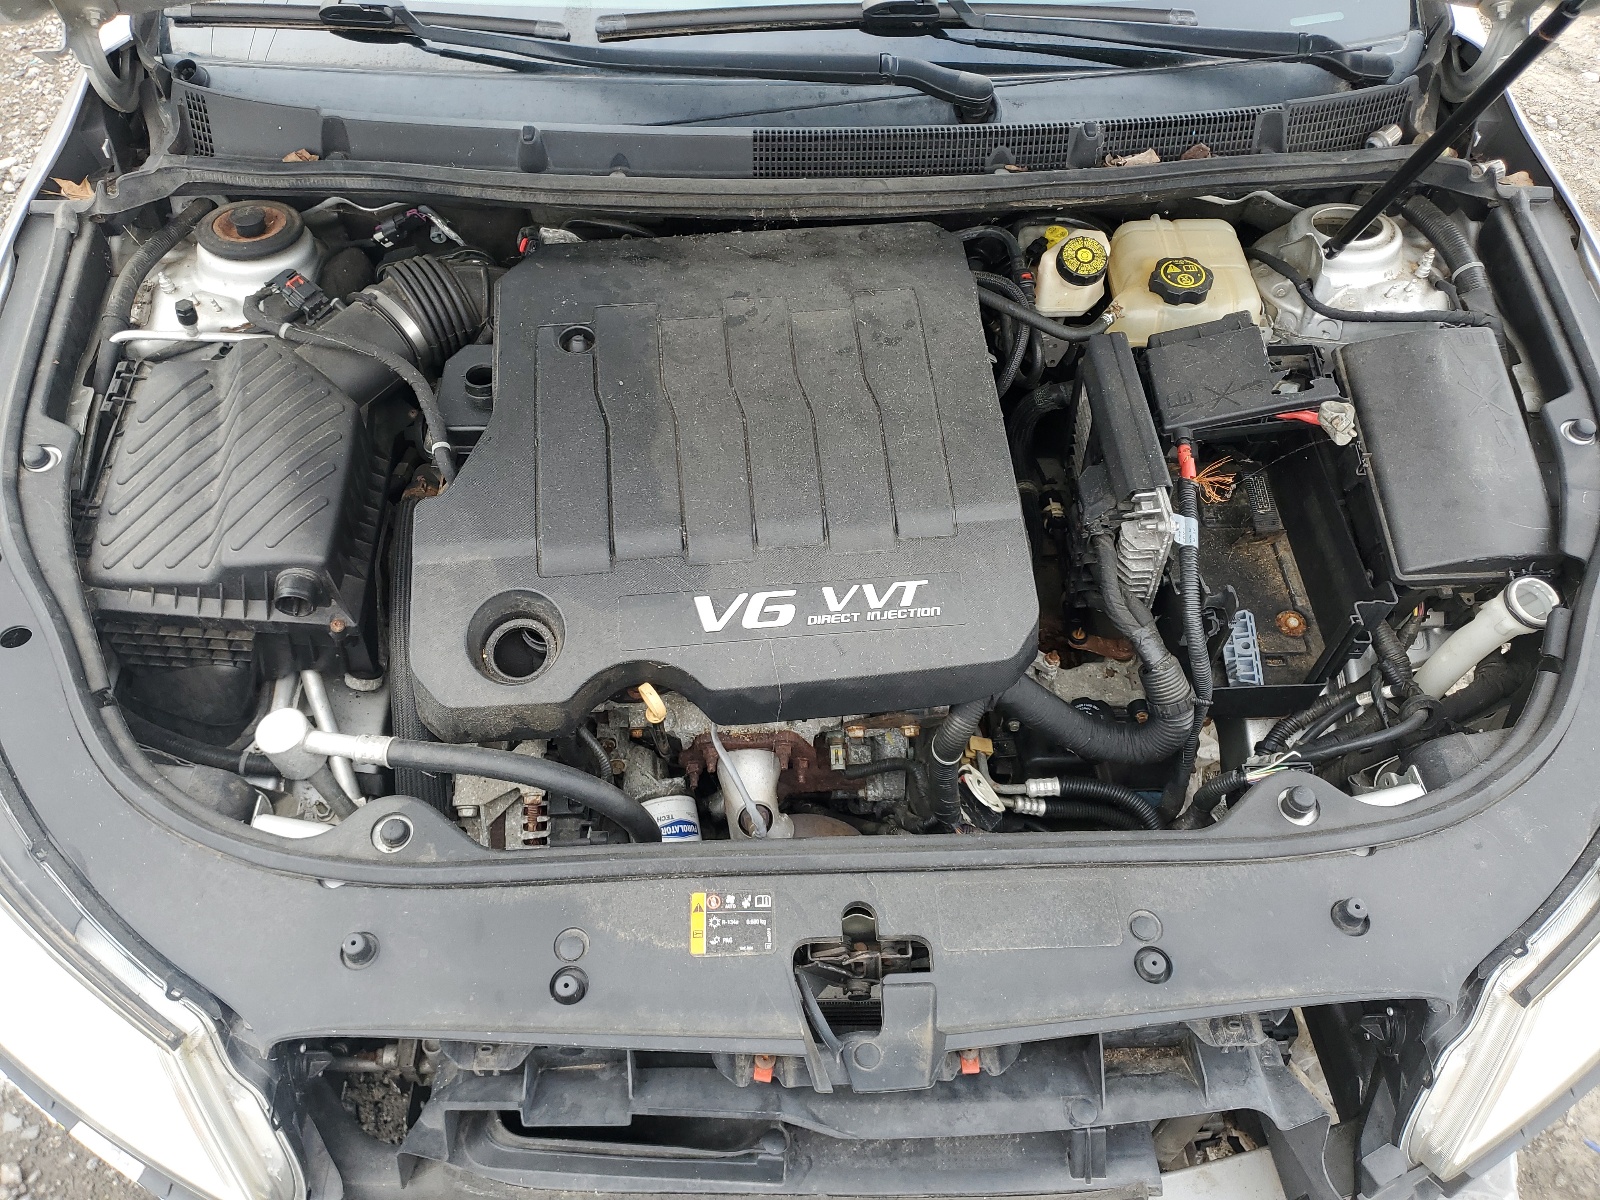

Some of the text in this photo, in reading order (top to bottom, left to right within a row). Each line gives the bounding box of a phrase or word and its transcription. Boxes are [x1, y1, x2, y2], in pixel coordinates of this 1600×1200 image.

[694, 580, 929, 633] V6 VVT
[807, 606, 942, 626] DIRECT INJECTION
[656, 814, 675, 822] TECH
